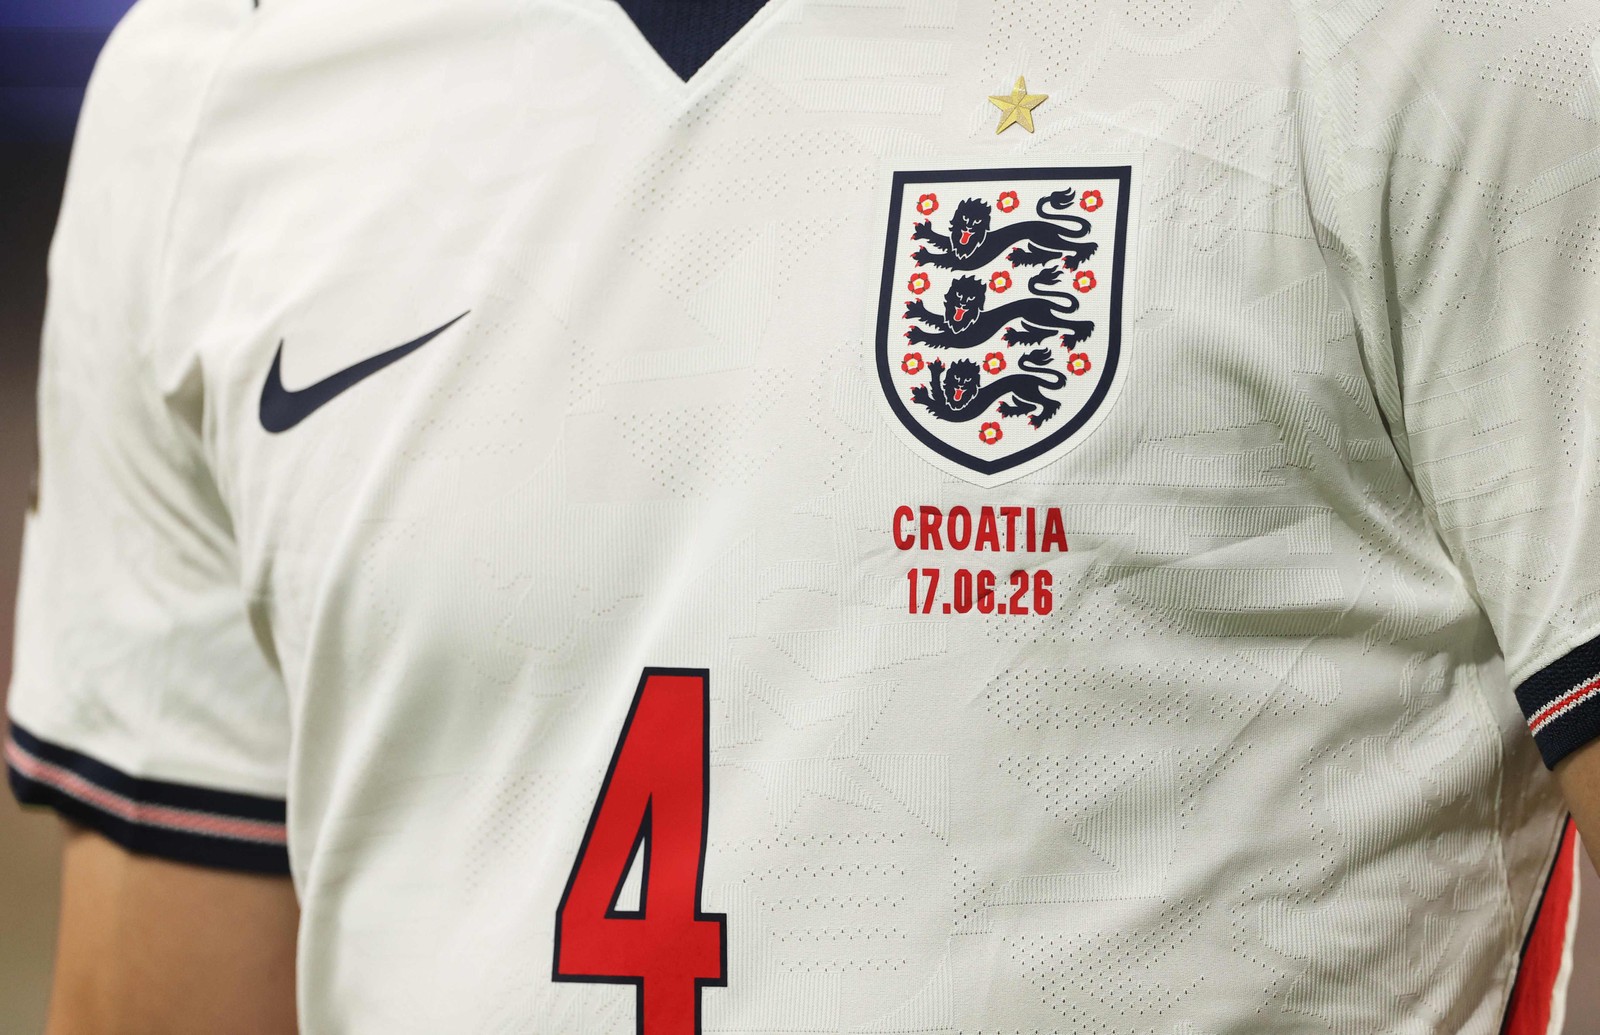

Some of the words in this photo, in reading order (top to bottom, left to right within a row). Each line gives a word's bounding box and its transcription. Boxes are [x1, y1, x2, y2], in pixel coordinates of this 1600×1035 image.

[893, 505, 1068, 552] CROATIA
[907, 568, 1052, 615] 17.06.26
[552, 667, 727, 1035] 4
